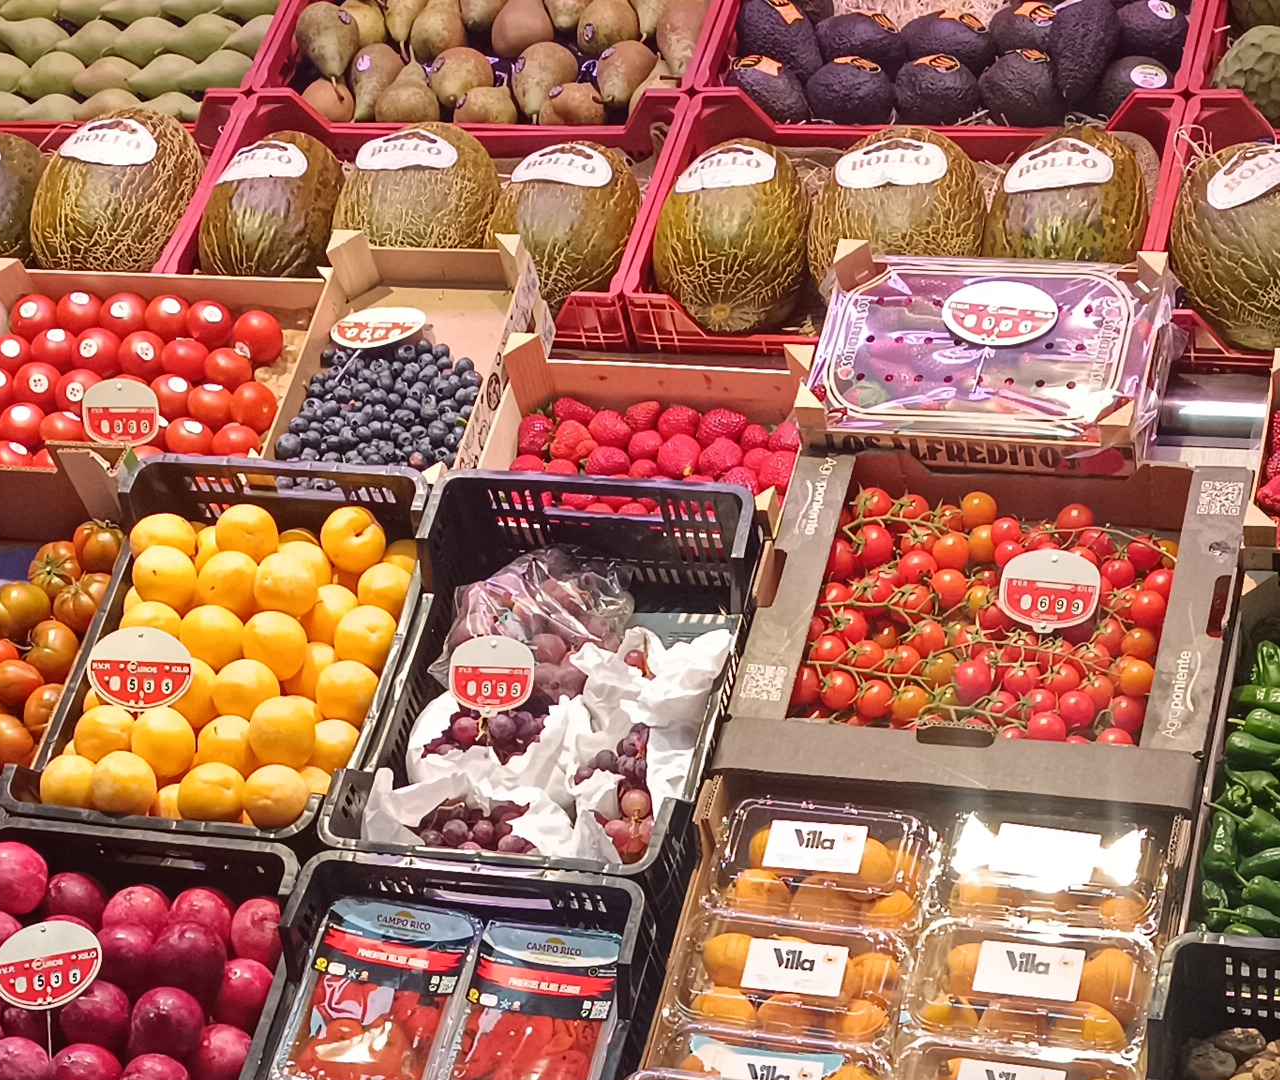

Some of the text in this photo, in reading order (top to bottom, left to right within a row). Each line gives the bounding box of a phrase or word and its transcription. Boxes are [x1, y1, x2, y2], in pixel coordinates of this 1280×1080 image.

[370, 141, 443, 159] BOLLO
[524, 156, 598, 175] BOLLO
[850, 151, 932, 172] BOLLO
[1017, 156, 1100, 180] BOLLO
[825, 433, 881, 451] LOS
[1161, 650, 1192, 738] Agroponiente
[794, 828, 836, 851] Villa
[376, 914, 431, 931] CAMPO RICO
[526, 941, 582, 956] CAMPO RICO
[773, 947, 816, 973] Villa
[1005, 949, 1051, 976] Villa
